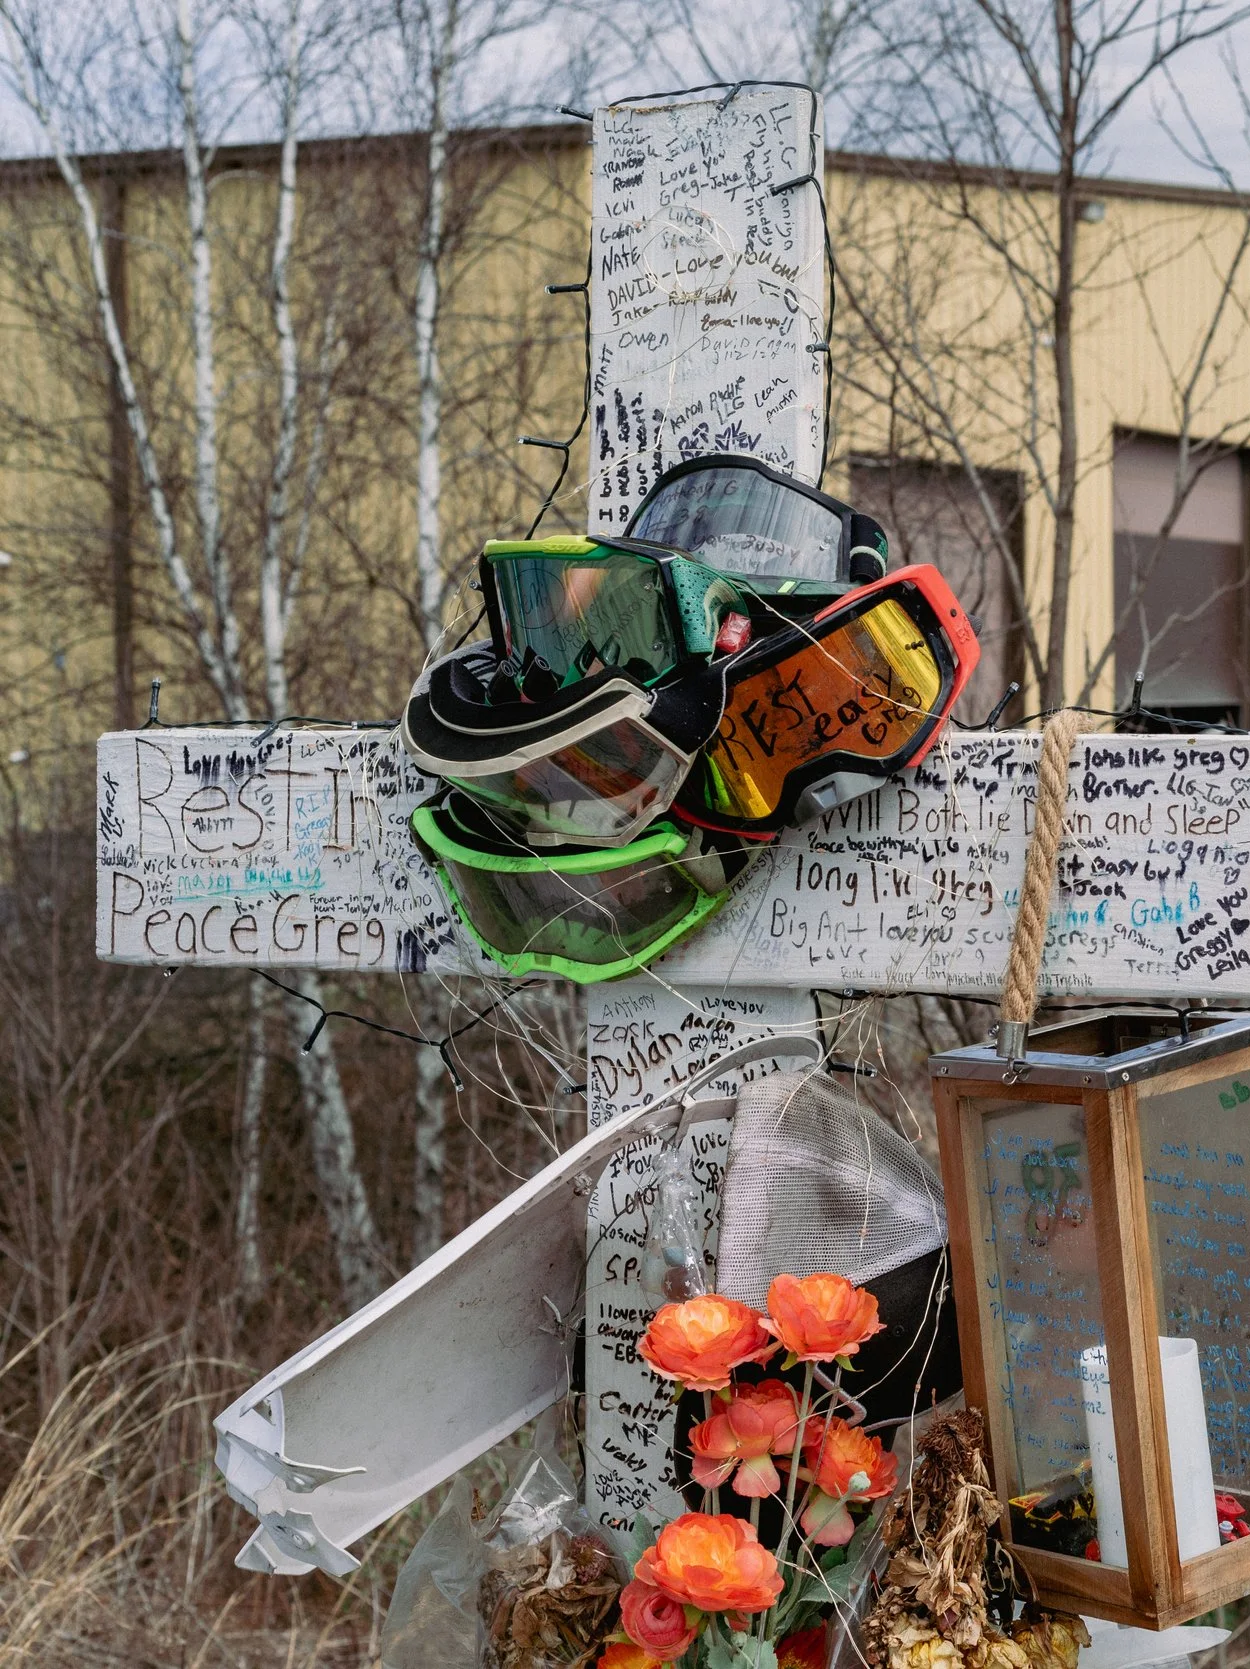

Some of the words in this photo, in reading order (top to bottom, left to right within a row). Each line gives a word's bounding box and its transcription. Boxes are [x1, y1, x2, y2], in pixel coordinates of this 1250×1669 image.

[716, 668, 817, 771] REST
[898, 789, 969, 835] Both
[979, 795, 1011, 833] lie
[1023, 796, 1092, 837] Dwn
[1105, 803, 1153, 837] and
[111, 871, 259, 958] Peace
[273, 894, 385, 967] Greg
[770, 897, 808, 950] Big
[591, 1032, 683, 1098] Dylan
[600, 1390, 674, 1423] Carter
